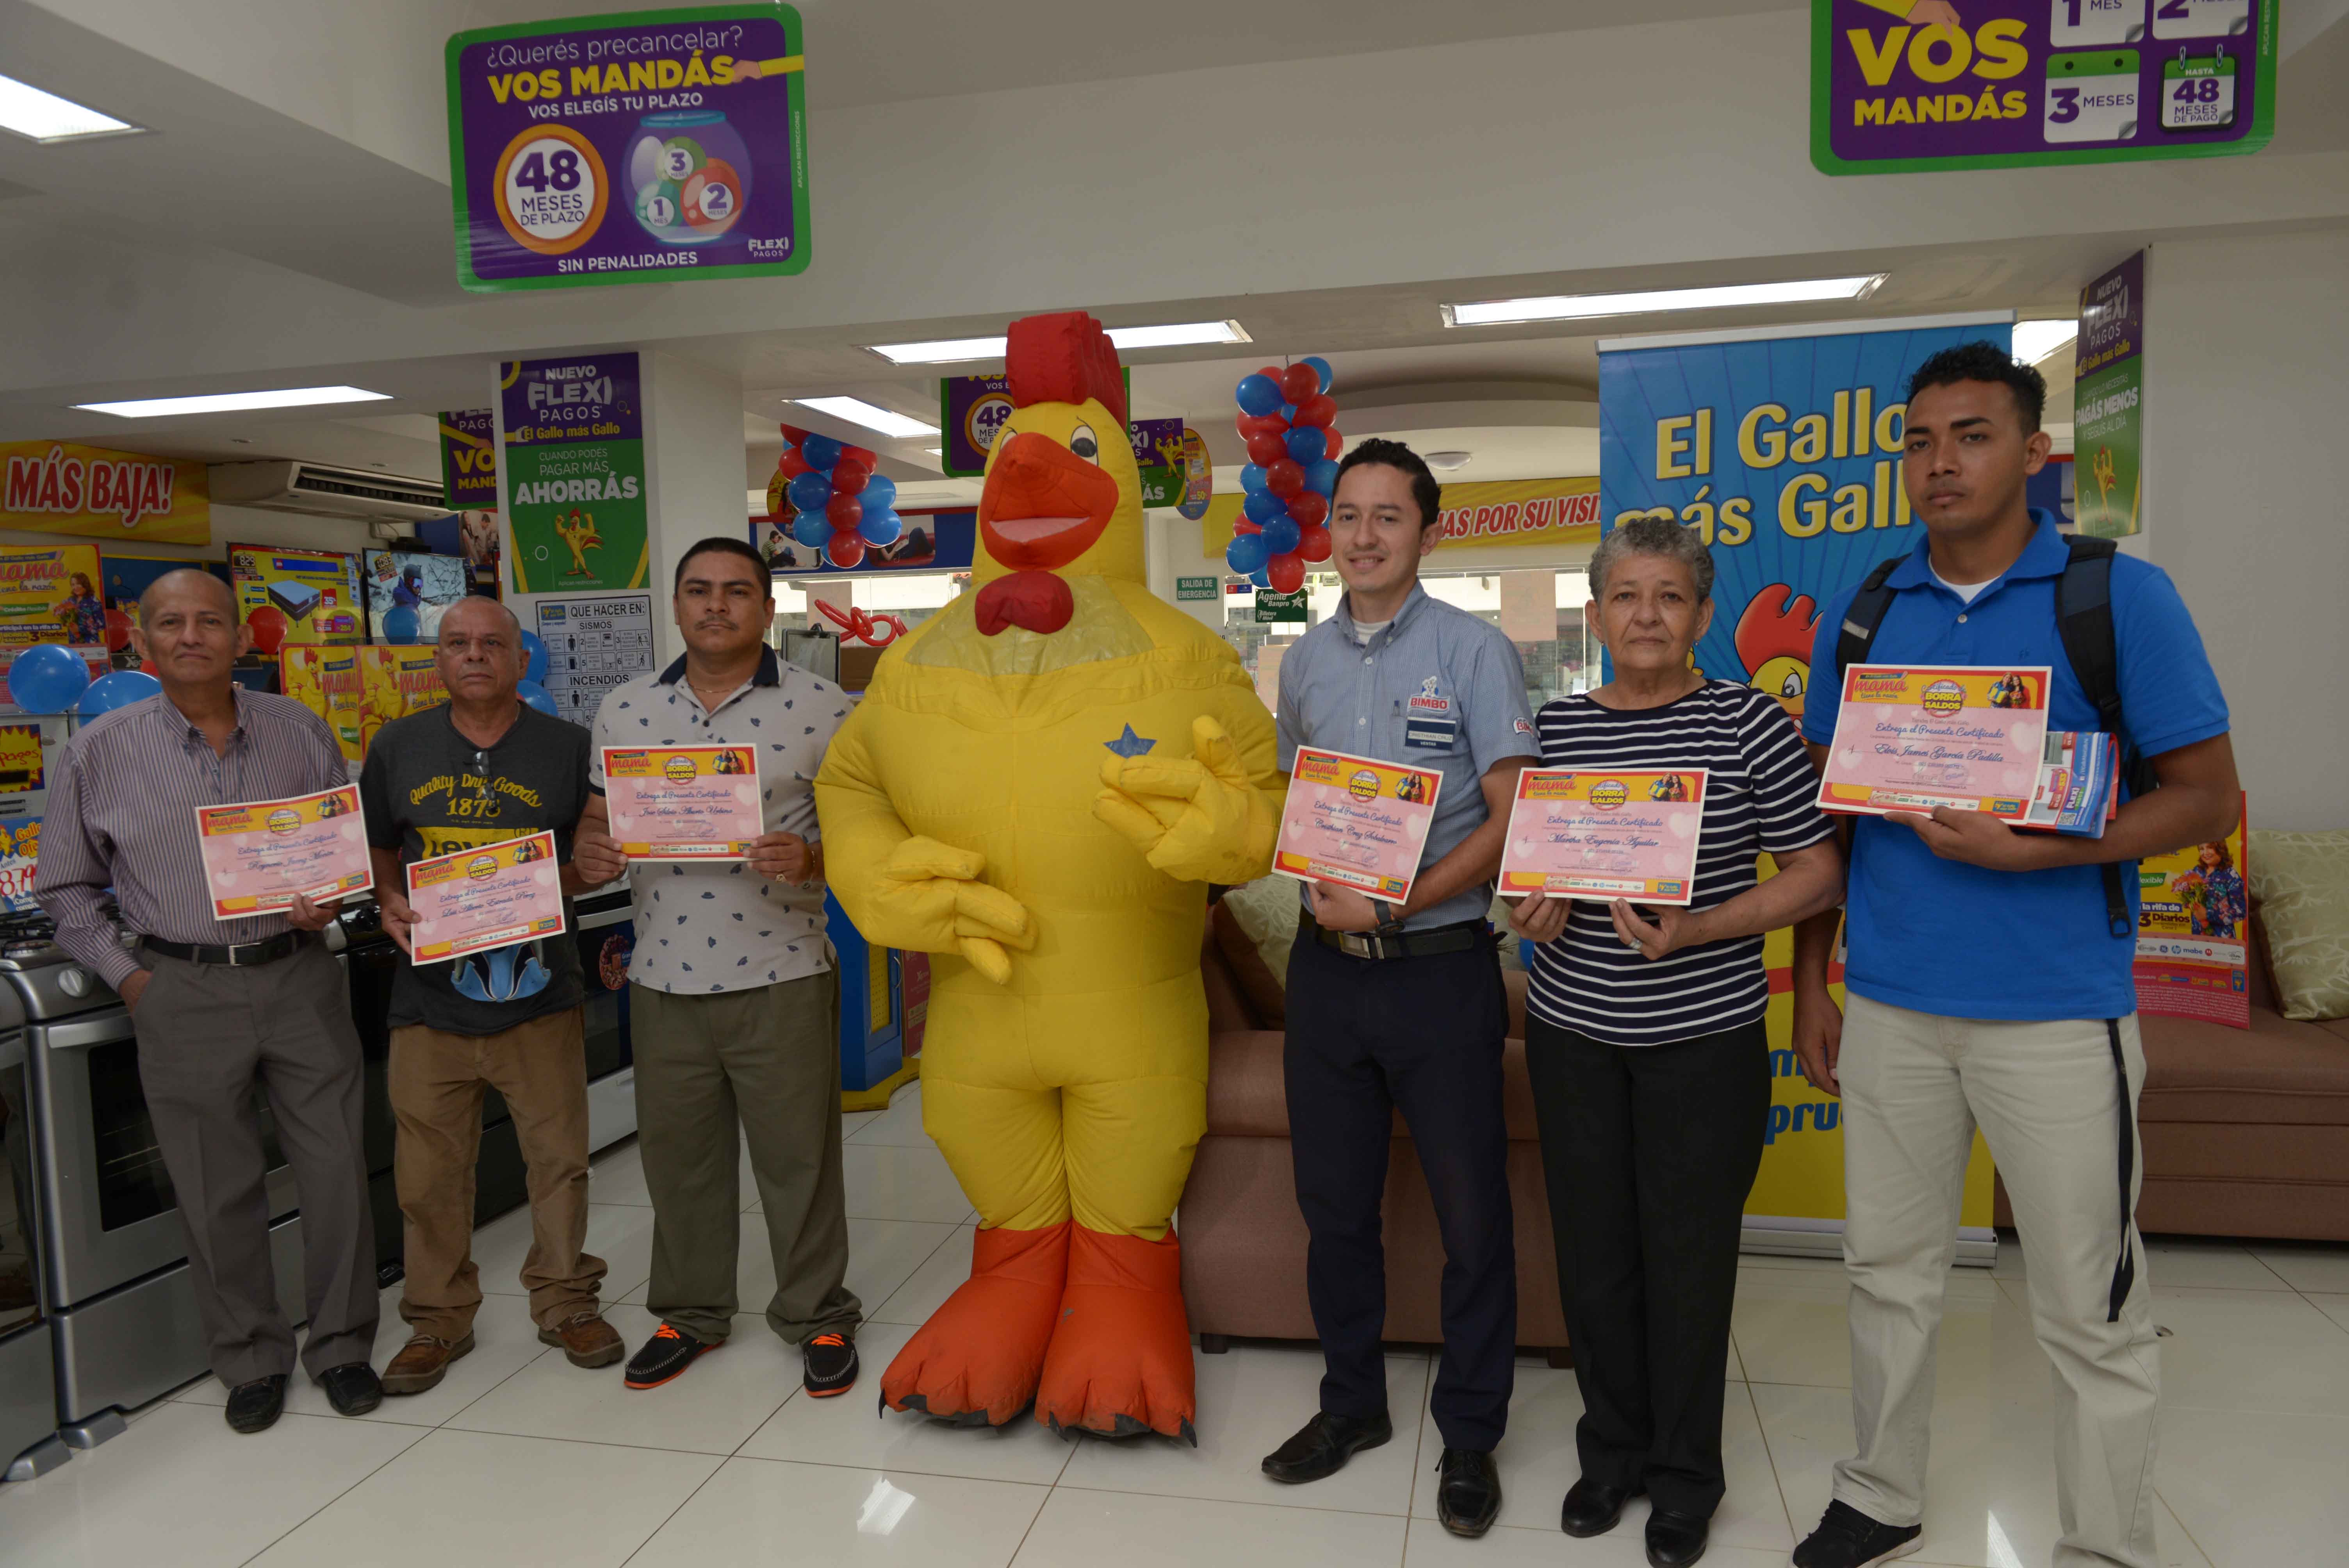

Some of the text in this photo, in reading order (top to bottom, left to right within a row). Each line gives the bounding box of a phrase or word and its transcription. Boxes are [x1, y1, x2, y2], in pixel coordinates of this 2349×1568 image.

[2091, 0, 2122, 11] MES
[487, 25, 743, 67] ¿Querés precancelar?
[1847, 18, 2028, 86] VOS
[487, 49, 734, 103] VOS MANDÁS
[2185, 68, 2214, 76] HASTA
[2173, 79, 2220, 104] 48
[528, 93, 703, 119] VOS ELEGÍS TU PLAZO
[1854, 85, 2027, 126] MANDÁS
[2049, 87, 2134, 123] 3 MESES
[2174, 105, 2218, 115] MESES
[671, 152, 685, 171] 3
[515, 149, 581, 194] 48
[521, 194, 583, 212] MESES
[707, 184, 727, 209] 2
[654, 199, 663, 216] 1
[520, 210, 585, 226] DE PLAZO
[749, 238, 789, 251] FLEXI
[558, 252, 697, 272] SIN PENALIDADES
[2097, 275, 2122, 301] NUEVO
[2091, 321, 2120, 349] PAGOS
[545, 365, 597, 380] NUEVO
[528, 376, 612, 410] FLEXI
[540, 406, 601, 422] PAGOS
[977, 406, 1011, 426] 48
[2076, 387, 2138, 428] PAGÁS MENOS
[524, 422, 620, 440] El Gallo más Gallo
[1656, 388, 1908, 480] El Gallo
[539, 450, 576, 461] CUANDO
[540, 458, 609, 476] PAGAR MÁS
[7, 448, 173, 524] MÁS BAJA!
[515, 471, 638, 505] AHORRÁS
[1778, 460, 1912, 539] Gall
[1474, 504, 1518, 534] POR
[1523, 501, 1551, 529] SU
[1178, 590, 1216, 599] EMERGENCIA
[1258, 591, 1287, 603] Agente
[571, 603, 645, 617] QUE HACER EN:
[579, 621, 612, 630] SISMOS
[570, 675, 629, 686] INCENDIOS
[1855, 672, 1908, 692] mamá
[1410, 697, 1448, 709] BIMBO
[1925, 692, 1962, 701] BORRA
[1925, 701, 1960, 709] SALDOS
[1876, 723, 2004, 739] Entrega el Presente Certificado
[1966, 749, 2004, 762] Padilla
[410, 773, 542, 807] Quality Dry Goods
[1350, 787, 1376, 797] SALDOS
[1351, 779, 1377, 790] BORRA
[636, 792, 660, 802] Entrega
[1314, 801, 1337, 814] Entrega
[1547, 816, 1576, 828] Entrega
[1586, 816, 1618, 825] Presente
[1620, 818, 1663, 828] Certificado
[2139, 912, 2190, 927] 3 Diarios
